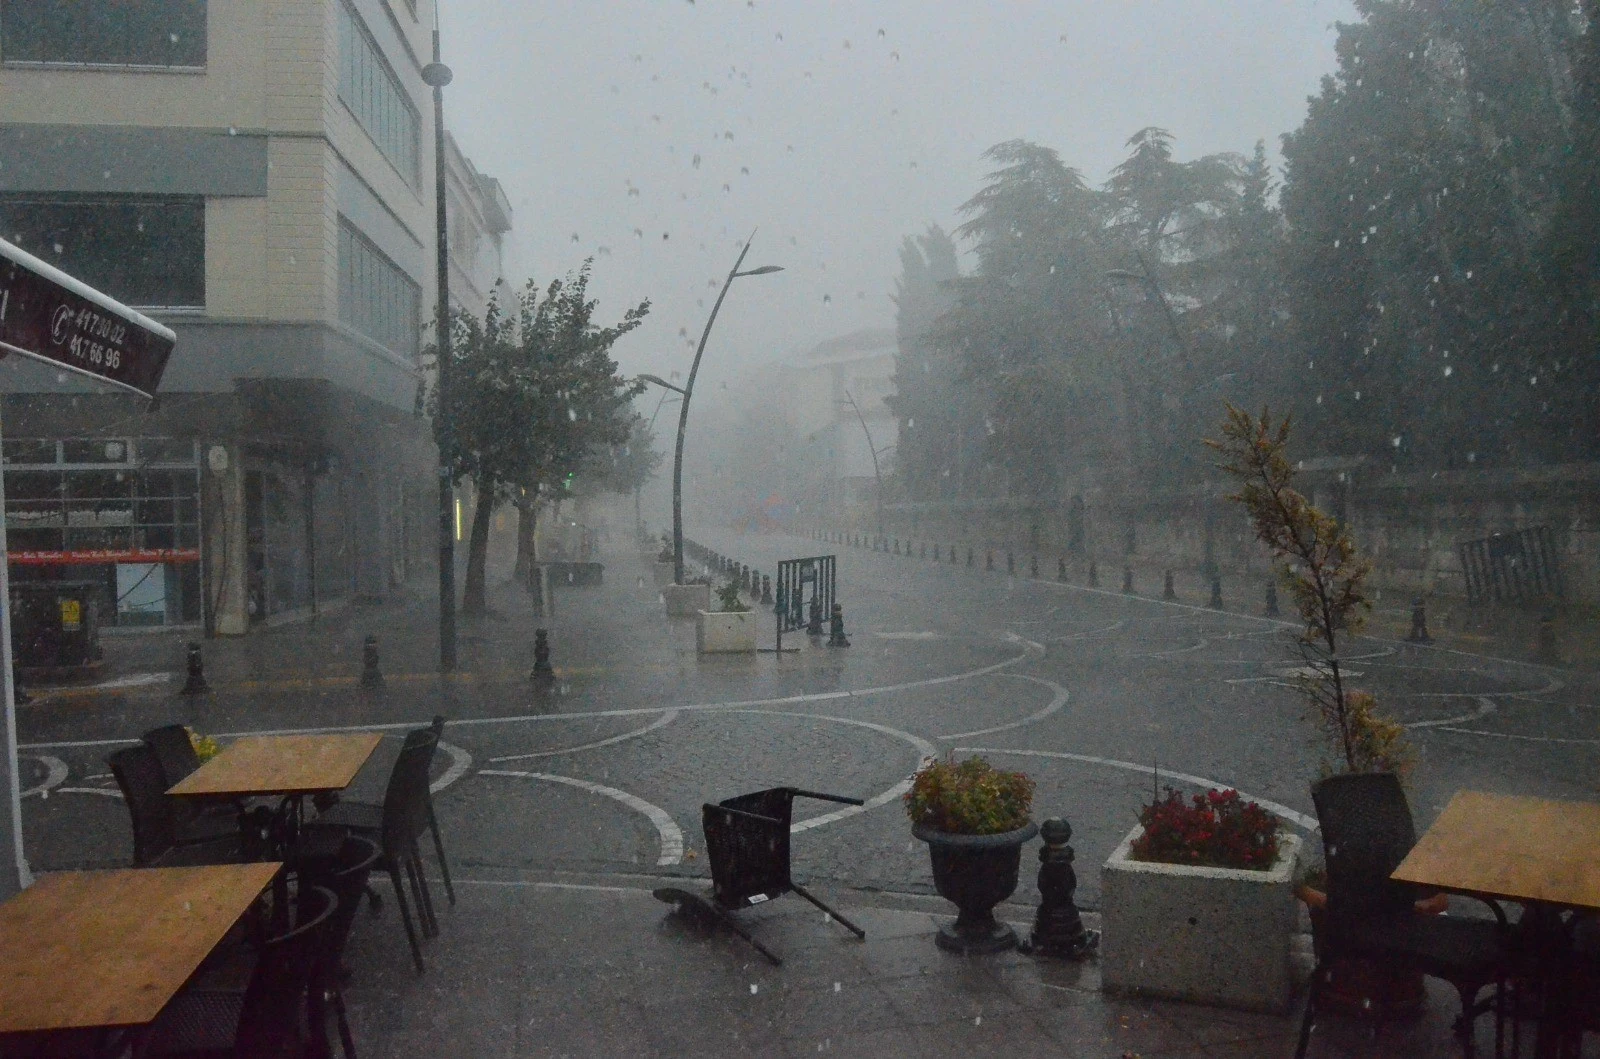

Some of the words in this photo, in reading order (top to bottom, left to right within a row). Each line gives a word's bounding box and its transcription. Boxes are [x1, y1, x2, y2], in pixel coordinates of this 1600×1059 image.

[76, 308, 99, 333] 417
[70, 334, 89, 359] 417
[90, 342, 104, 364] 66
[105, 347, 121, 369] 96
